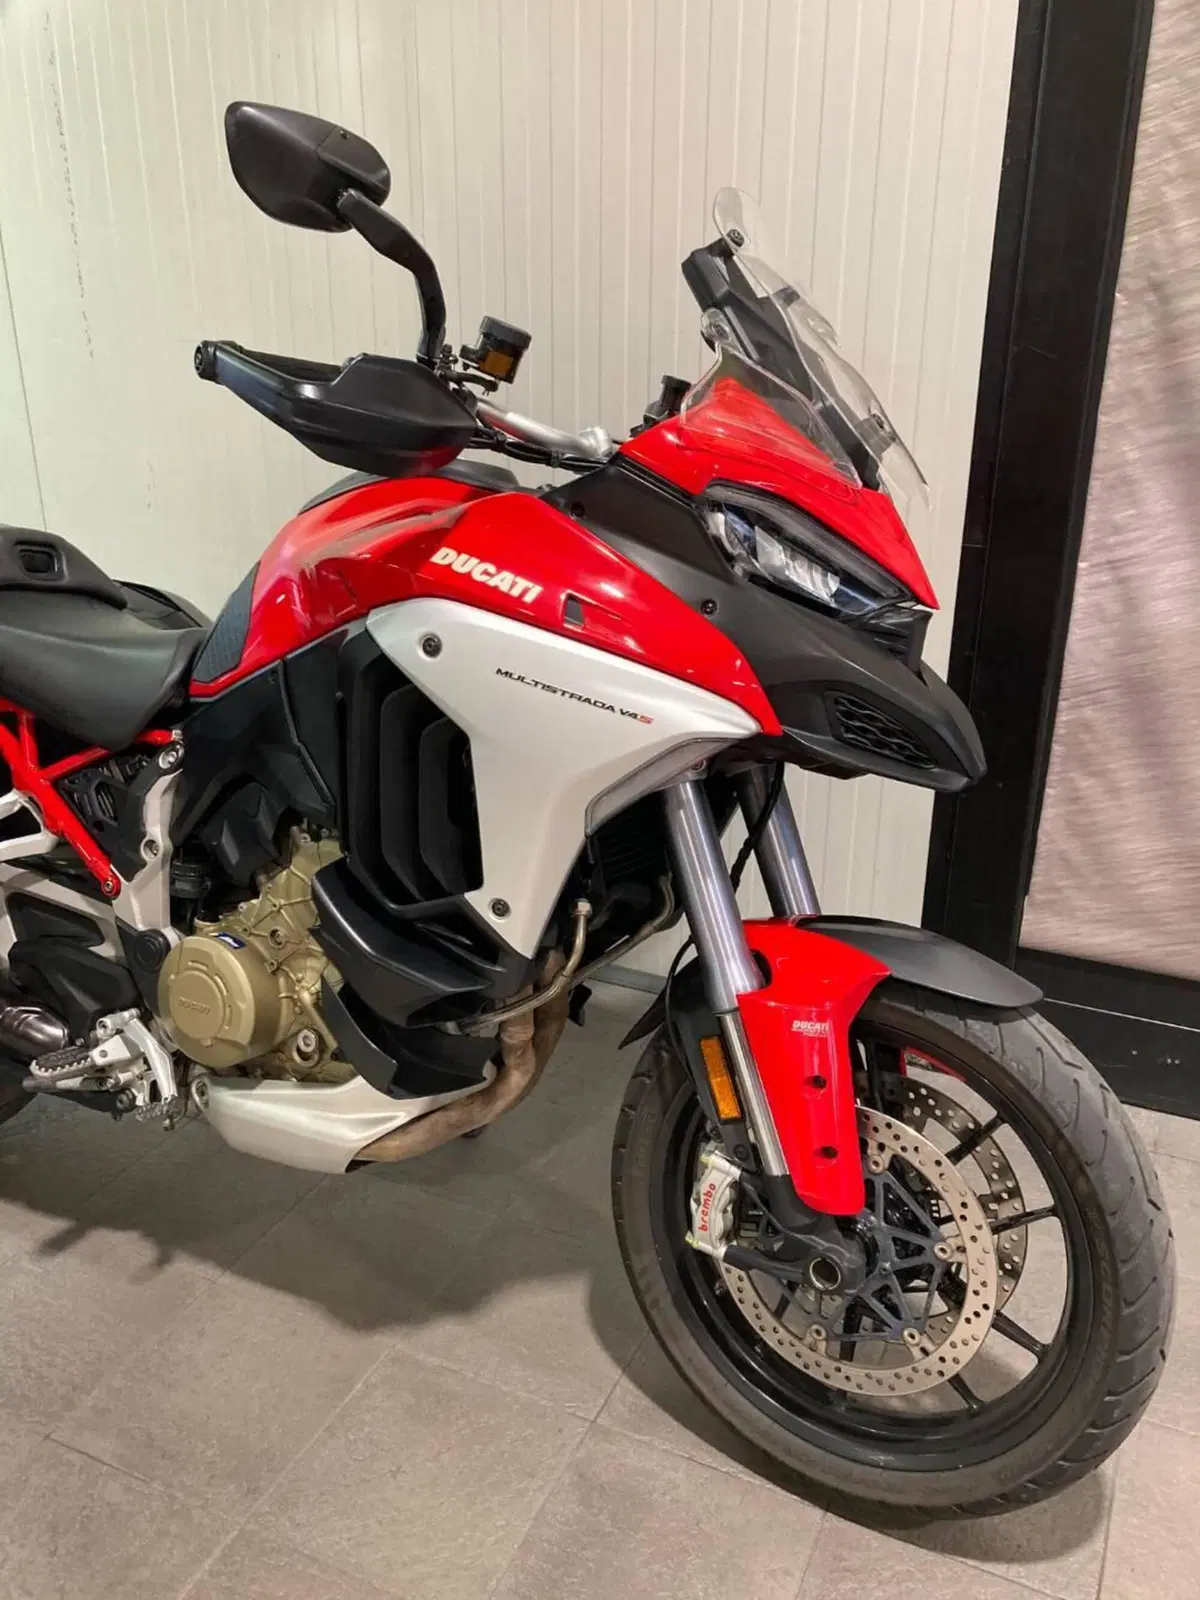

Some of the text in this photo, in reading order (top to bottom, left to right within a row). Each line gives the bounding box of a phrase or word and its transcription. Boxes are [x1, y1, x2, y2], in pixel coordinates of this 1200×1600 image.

[429, 547, 544, 604] DUCATI
[495, 668, 654, 725] MULTISTRADA V4S
[791, 1020, 829, 1032] DUCATI
[698, 1183, 716, 1232] brembo
